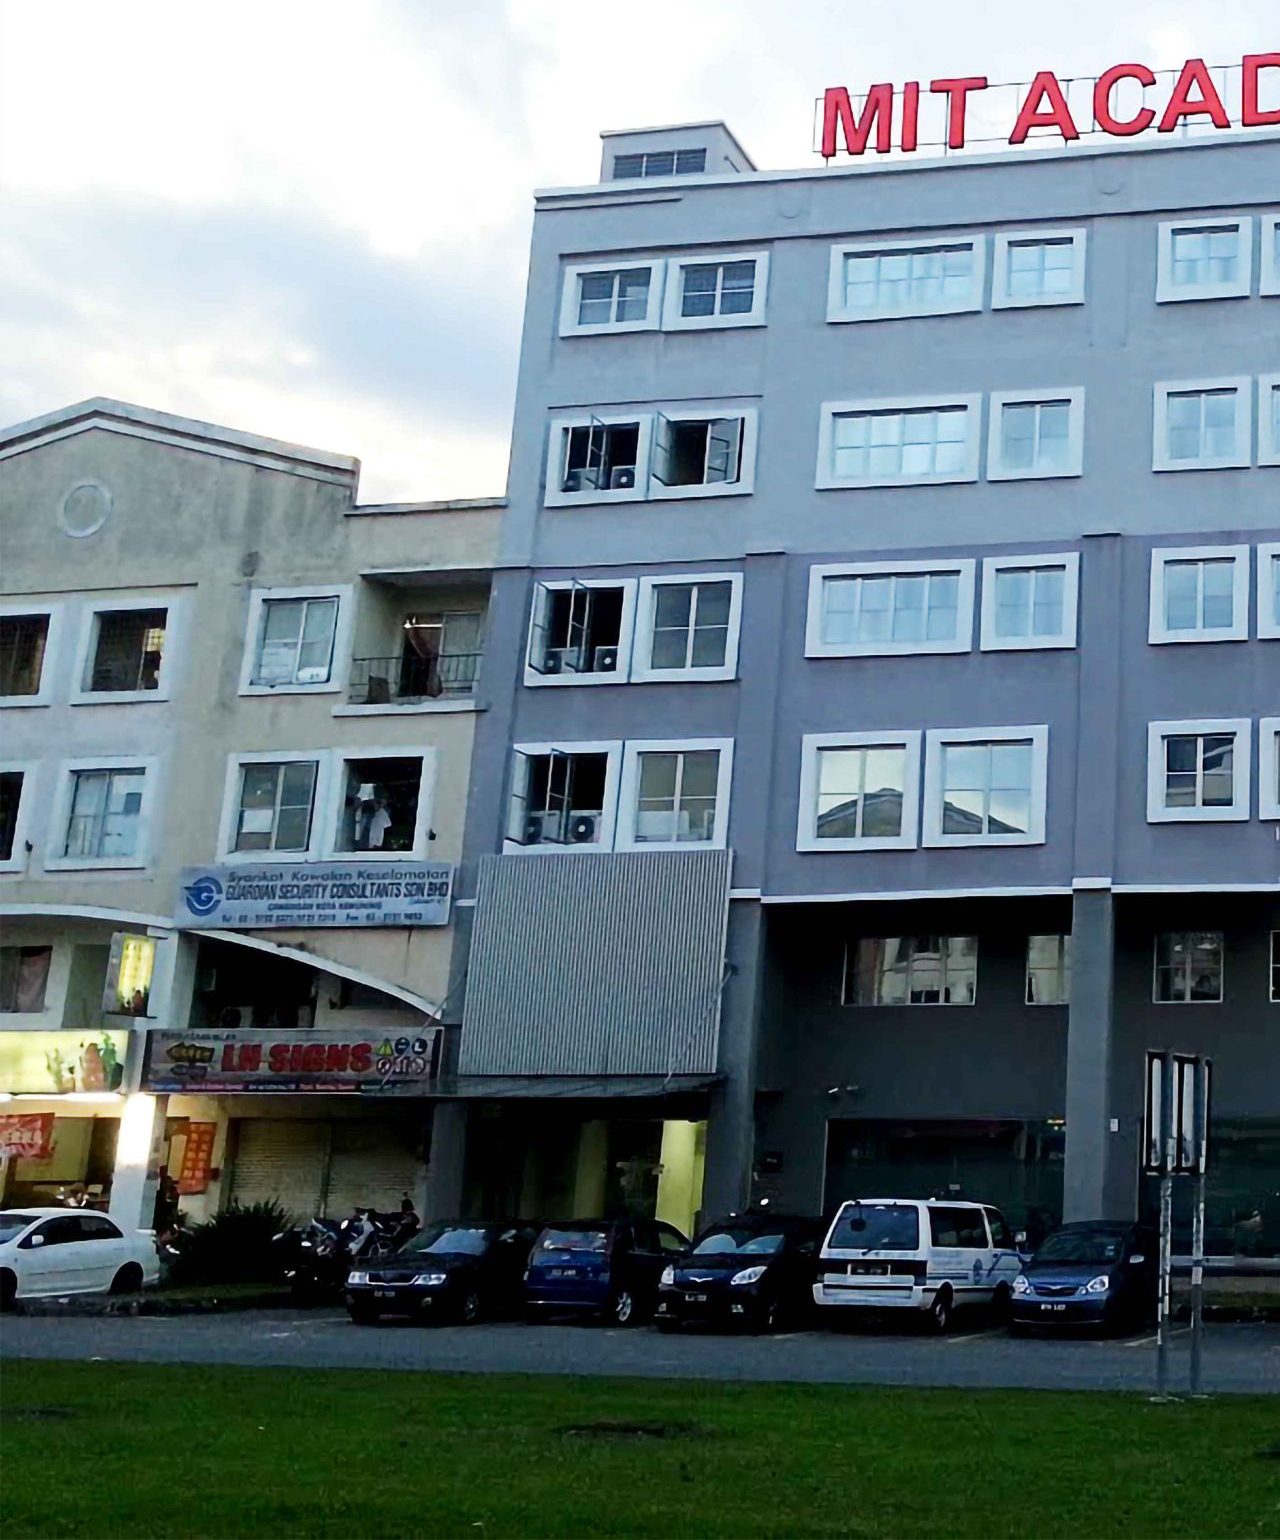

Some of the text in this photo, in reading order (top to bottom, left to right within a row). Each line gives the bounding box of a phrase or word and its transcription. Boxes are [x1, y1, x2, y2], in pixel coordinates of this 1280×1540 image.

[821, 76, 988, 158] MIT
[279, 883, 328, 900] SECURITY
[329, 882, 402, 899] CONSULTANTS
[268, 1043, 373, 1072] SIGNS
